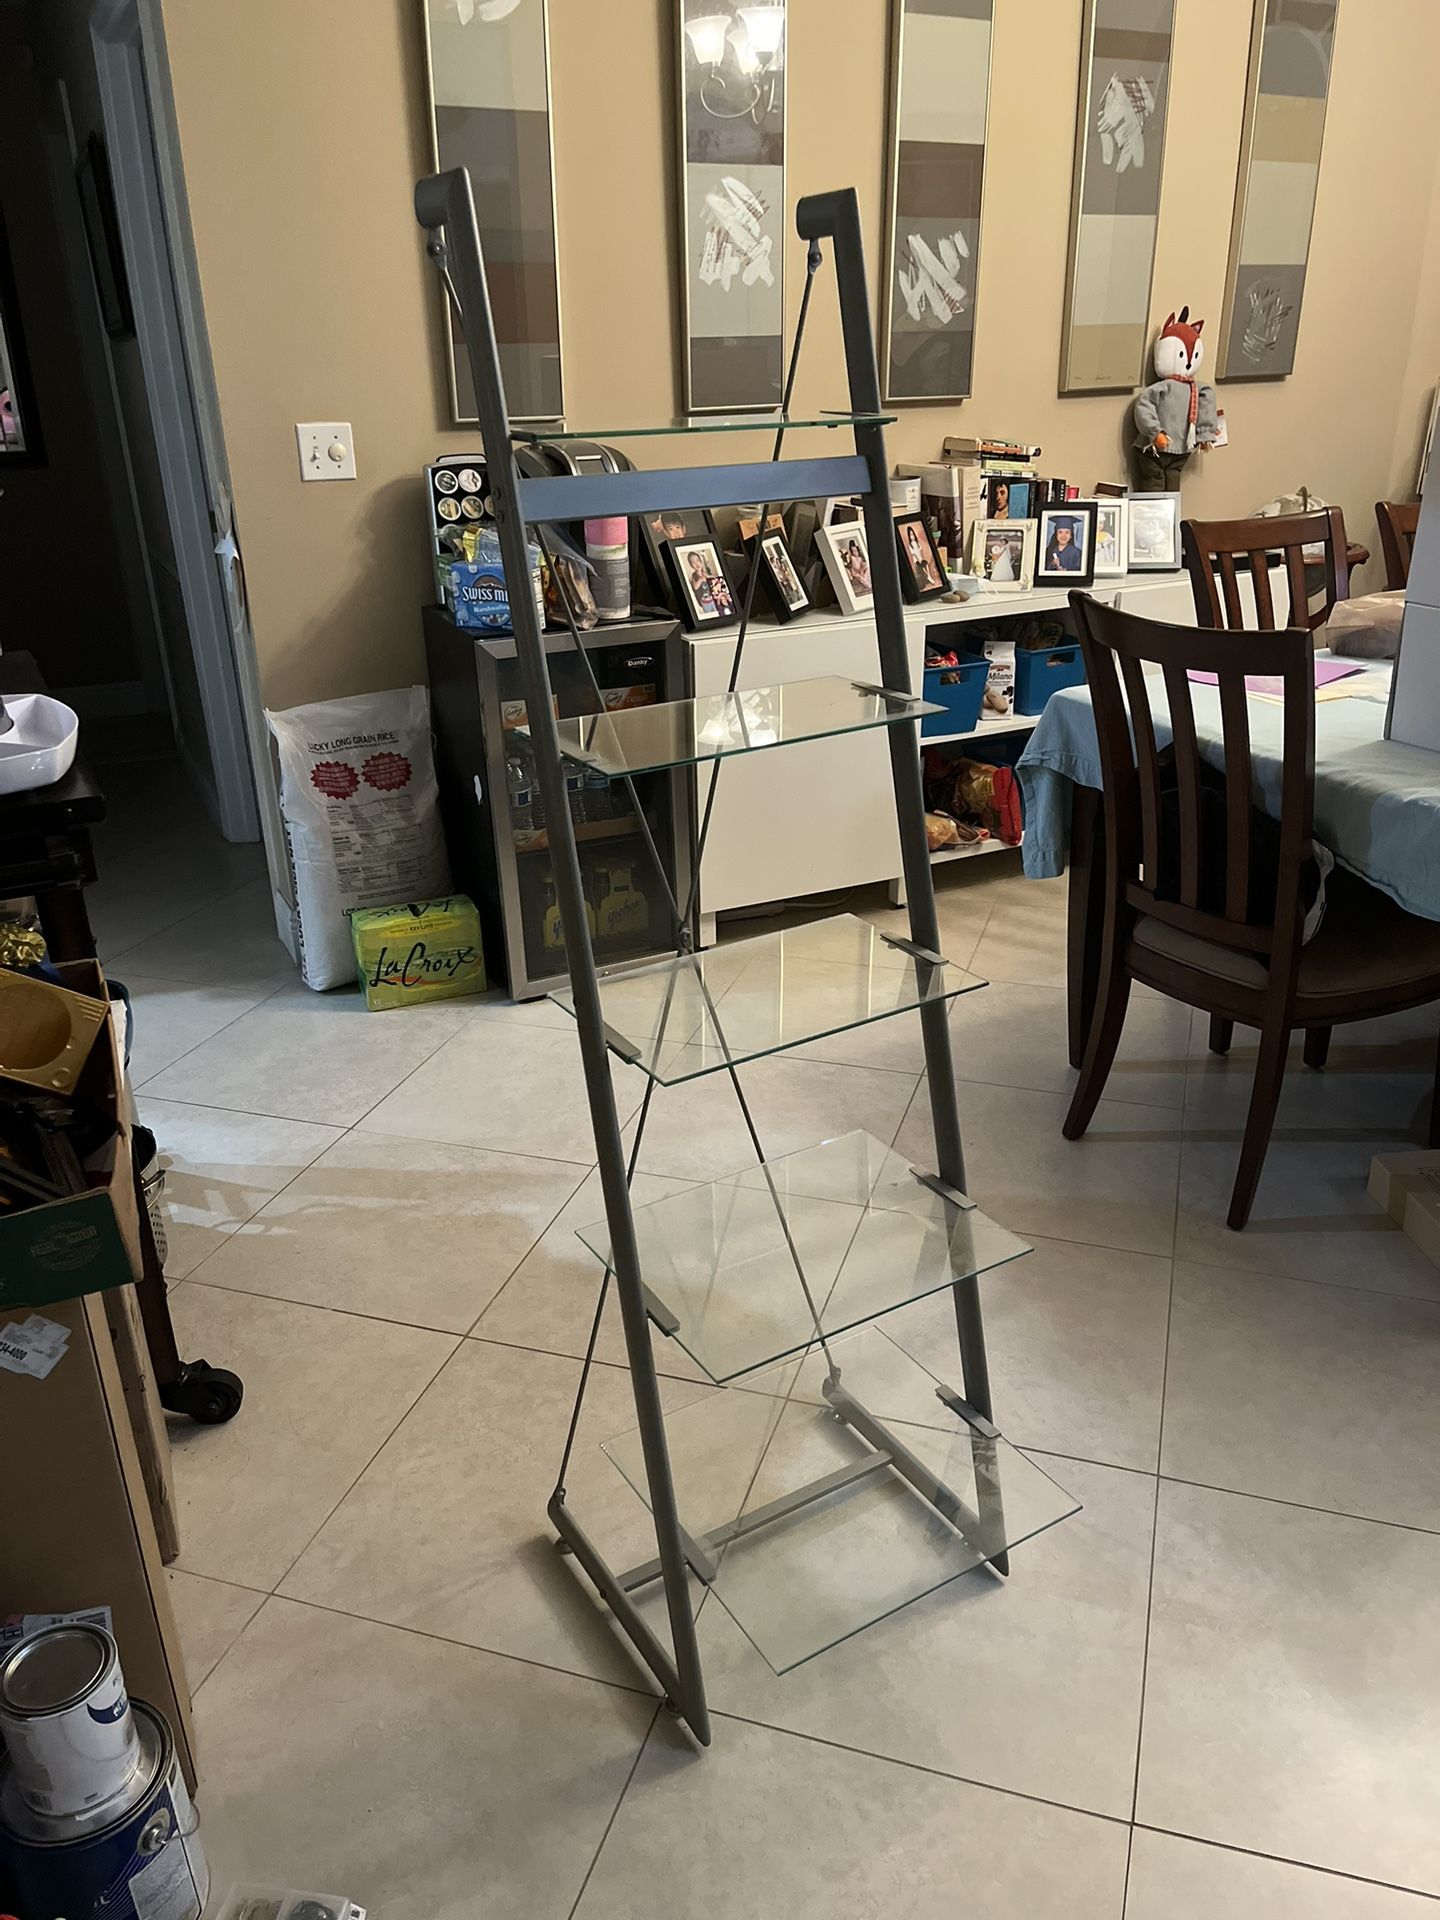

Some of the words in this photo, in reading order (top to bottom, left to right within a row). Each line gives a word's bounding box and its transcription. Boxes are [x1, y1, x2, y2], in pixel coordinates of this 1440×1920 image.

[989, 672, 1013, 681] Milano
[331, 737, 352, 749] LONG
[352, 734, 376, 745] GRAIN
[377, 731, 395, 741] RICE
